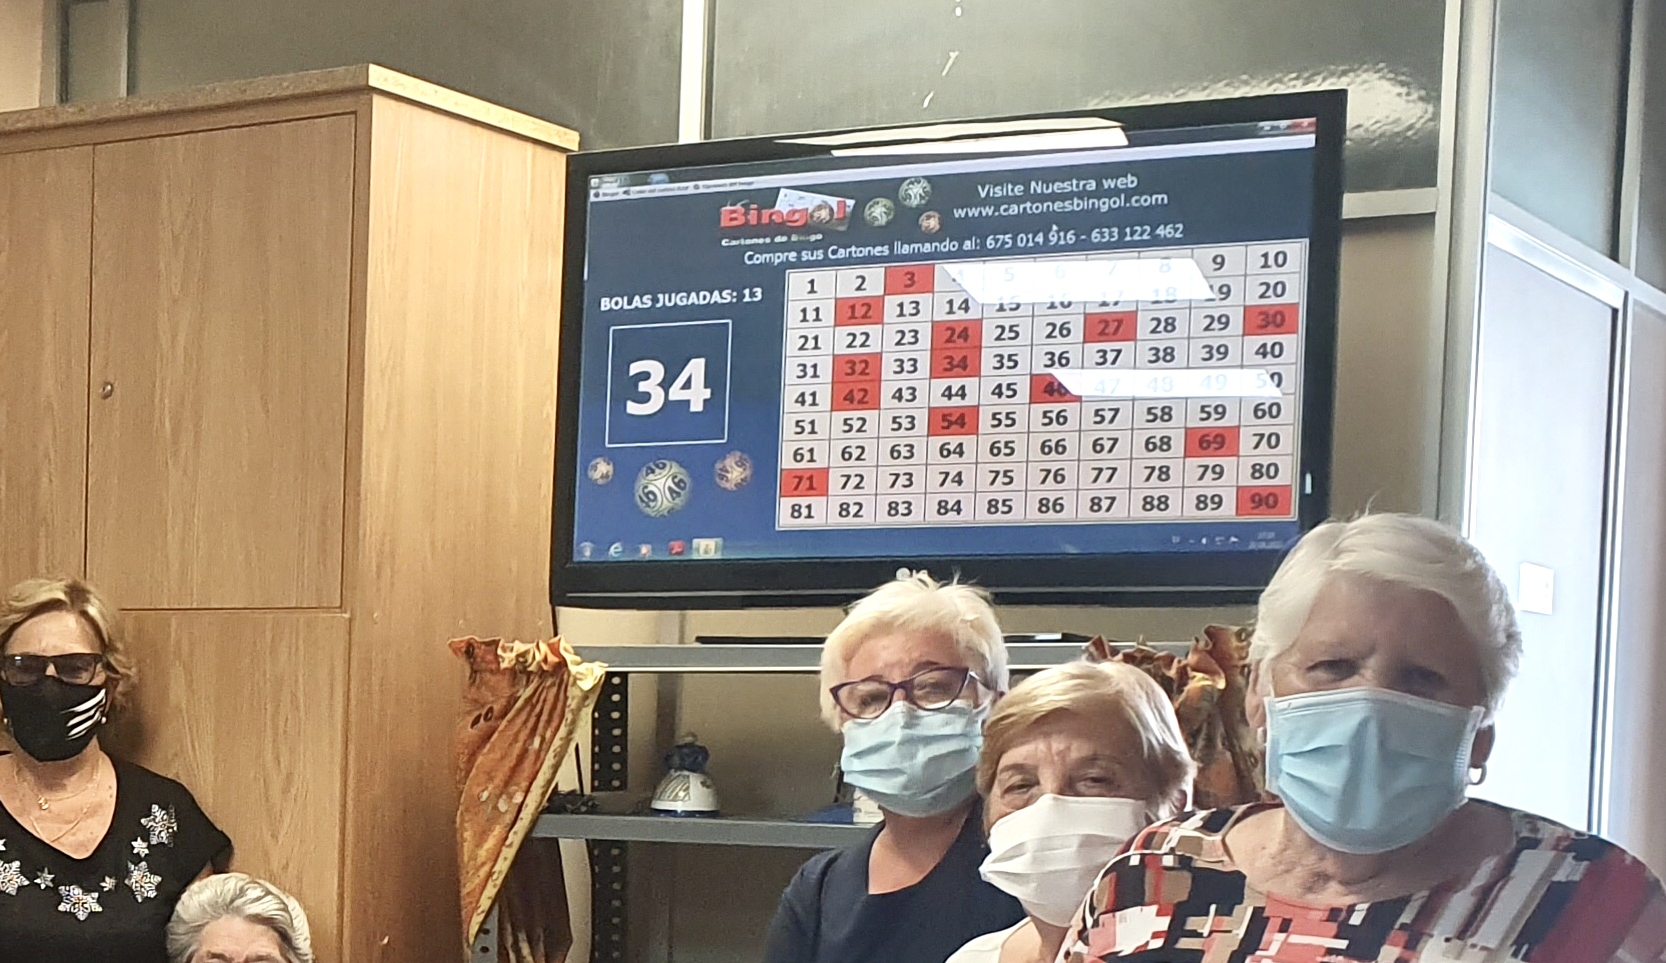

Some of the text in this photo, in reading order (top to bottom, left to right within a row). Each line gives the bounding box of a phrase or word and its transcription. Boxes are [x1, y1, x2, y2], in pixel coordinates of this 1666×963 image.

[977, 173, 1138, 198] Visite Nuestra web
[953, 193, 1168, 219] www.cartonesbingol.com
[744, 250, 797, 266] Compre
[800, 248, 824, 262] sus
[827, 242, 890, 259] Cartones
[893, 237, 958, 255] llamando
[962, 236, 980, 251] al:
[986, 234, 1013, 249] 675
[1017, 232, 1044, 247] 014
[1048, 229, 1076, 246] 916
[1091, 227, 1119, 243] 633
[1124, 225, 1151, 241] 122
[1155, 223, 1184, 239] 462
[806, 278, 818, 295] 1
[854, 274, 867, 292] 2
[902, 270, 917, 289] 3
[1211, 253, 1226, 272] 9
[1259, 250, 1288, 270] 10
[600, 287, 763, 311] BOLAS JUGADAS: 13
[799, 306, 823, 323] 11
[846, 303, 872, 321] 12
[895, 300, 921, 318] 13
[945, 297, 971, 316] 14
[1257, 280, 1287, 300] 20
[797, 310, 1287, 352] 21 22 23 24 25 26 27 28 29 30
[795, 341, 1285, 380] 31 32 33 34 35 36 37 38 39 40
[626, 357, 712, 416] 34
[794, 390, 820, 407] 41
[842, 387, 869, 405] 42
[890, 385, 918, 404] 43
[940, 384, 968, 402] 44
[990, 382, 1018, 400] 45
[793, 401, 1282, 436] 51 52 53 54 55 56 57 58 59 60
[792, 431, 1281, 464] 61 62 63 64 65 66 67 68 69 70
[791, 462, 1280, 492] 71 72 73 74 75 76 77 78 79 80
[790, 492, 1278, 520] 81 82 83 84 85 86 87 88 89 90
